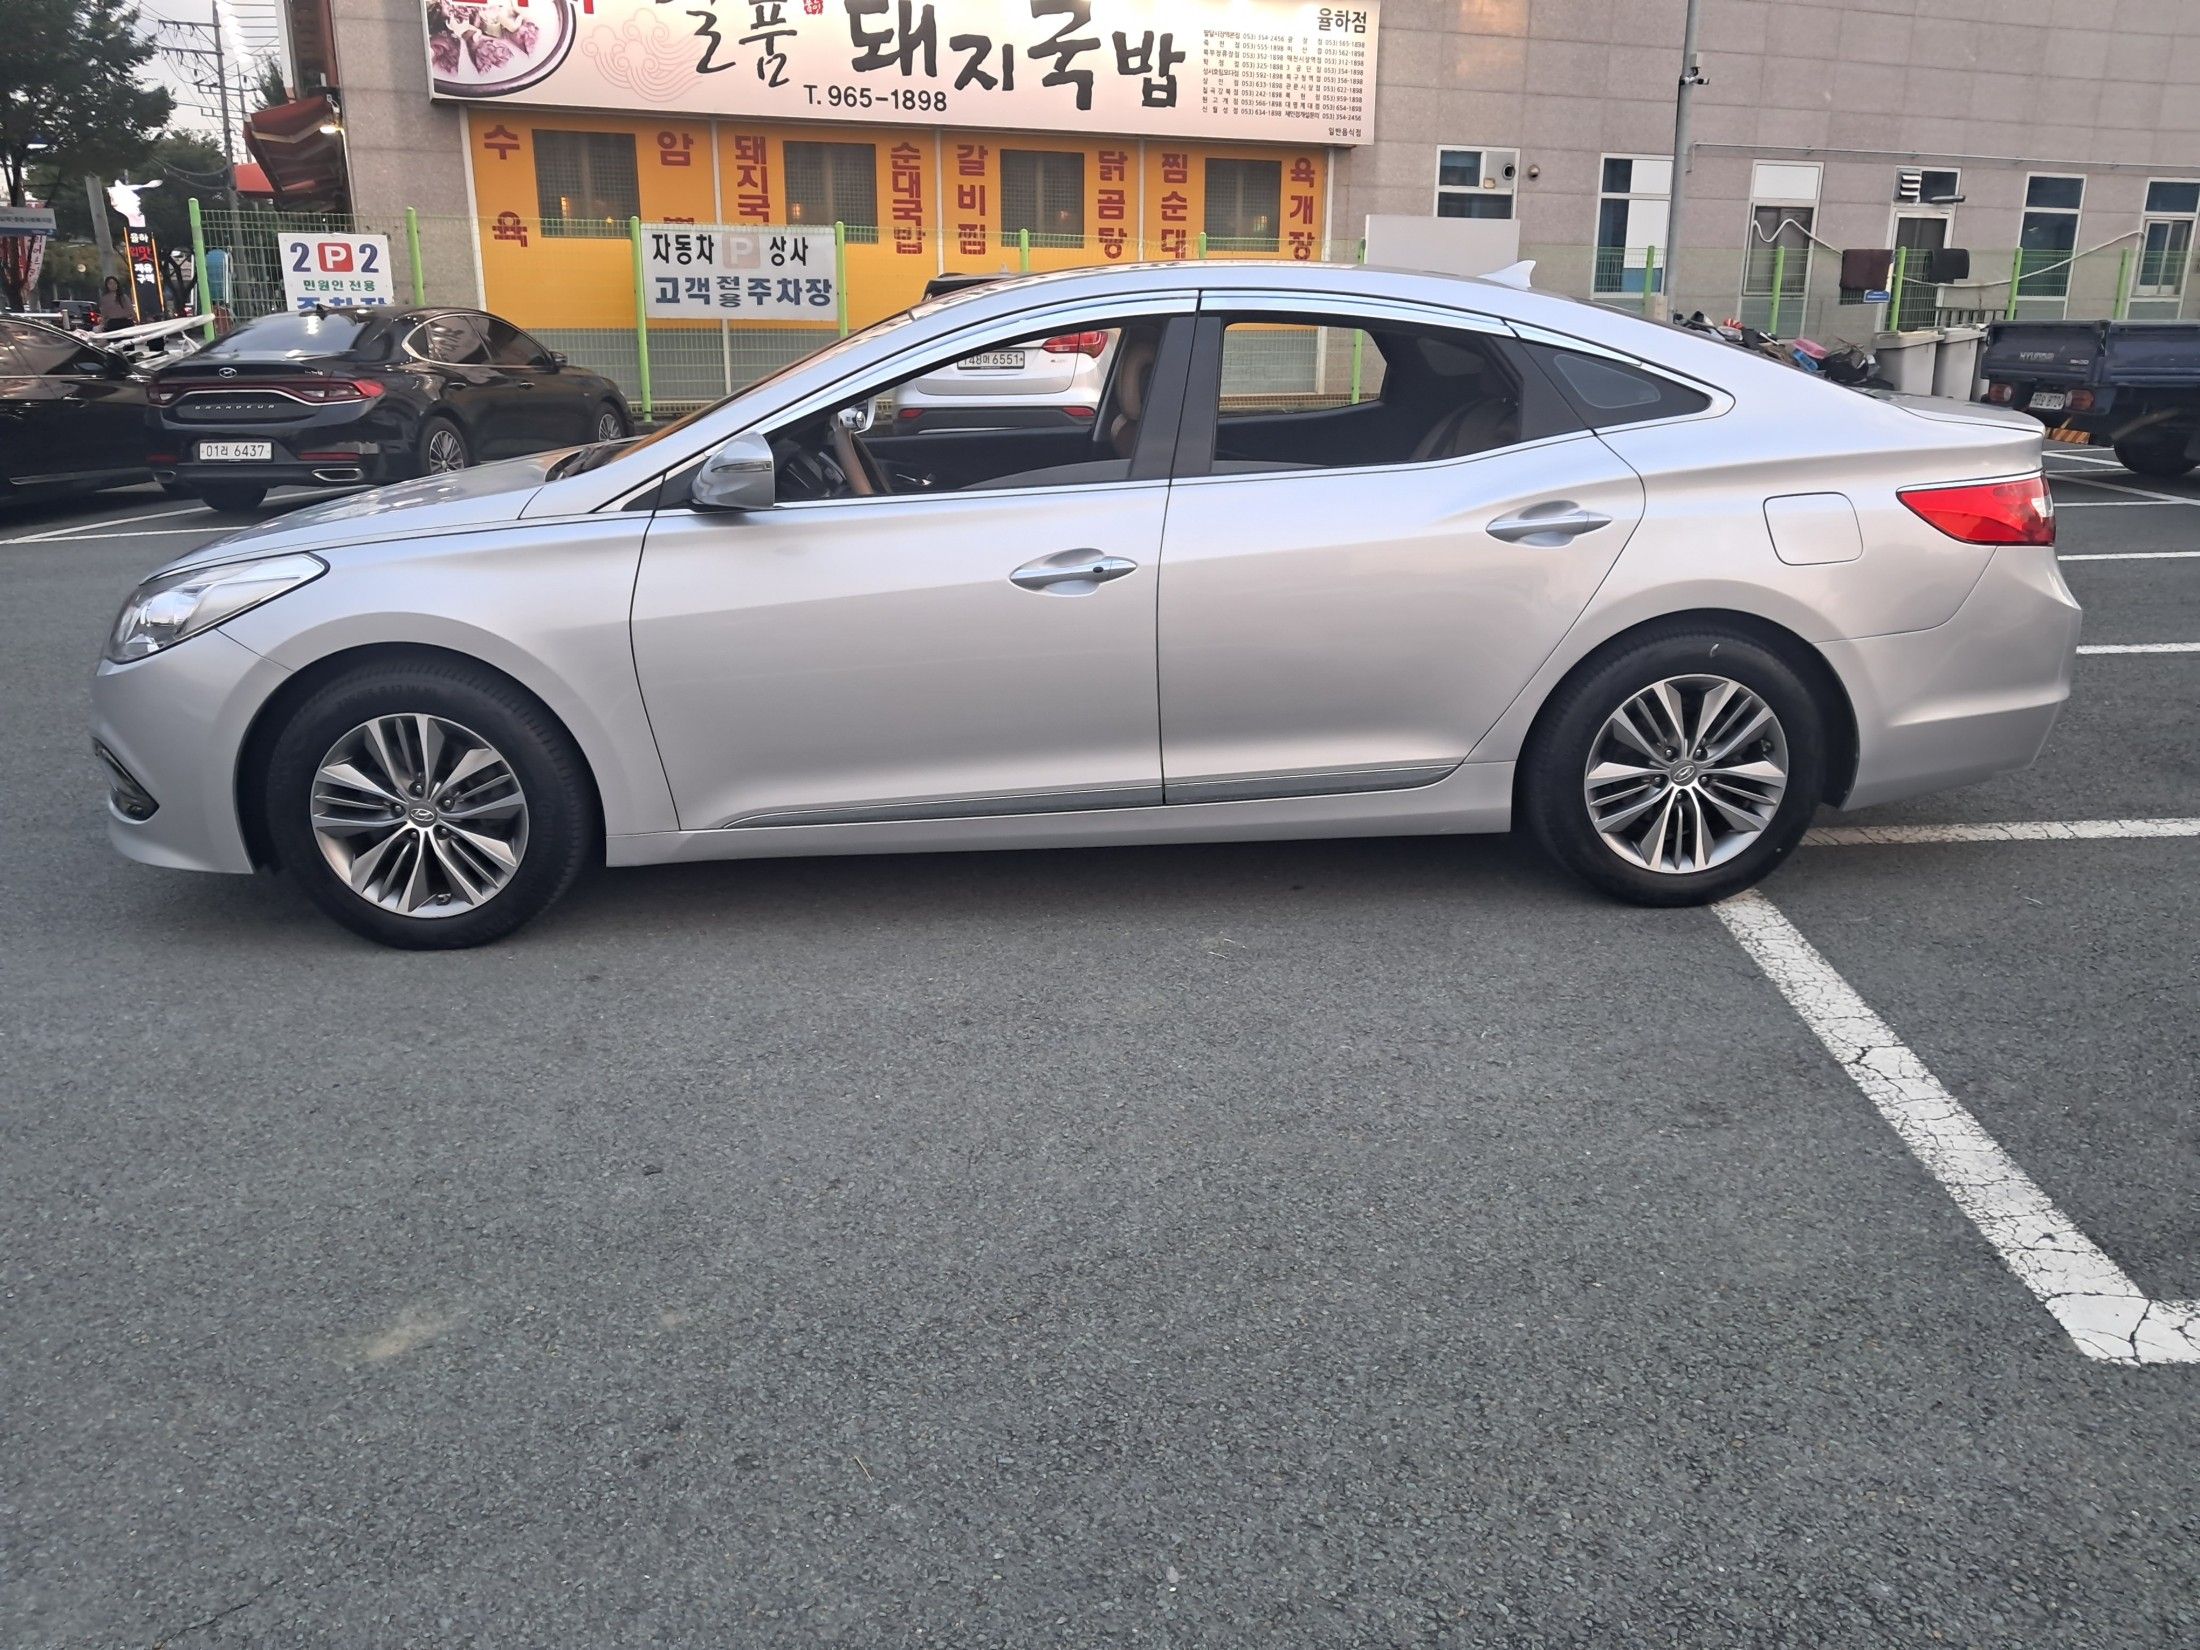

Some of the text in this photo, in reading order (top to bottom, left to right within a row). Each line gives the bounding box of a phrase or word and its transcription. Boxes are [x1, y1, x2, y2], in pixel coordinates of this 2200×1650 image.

[1317, 7, 1367, 34] 율하점
[845, 0, 1186, 110] 돼지국밥
[827, 87, 947, 112] 965-1898
[1328, 127, 1362, 137] 일반음식점
[735, 135, 770, 226] 돼지국
[890, 142, 926, 255] 순대국밥
[957, 144, 989, 256] 갈비찜
[1097, 150, 1128, 260] 닭곰탕
[1161, 152, 1188, 259] 찜순대
[1289, 156, 1315, 261] 육개장
[290, 242, 312, 273] 2
[359, 243, 379, 273] 2
[652, 233, 714, 265] 자동차
[769, 235, 808, 266] 상사
[303, 279, 376, 292] 민원인 전용
[655, 275, 833, 308] 고객 전용 주차장
[992, 353, 1019, 366] 6551
[234, 444, 265, 457] 6437
